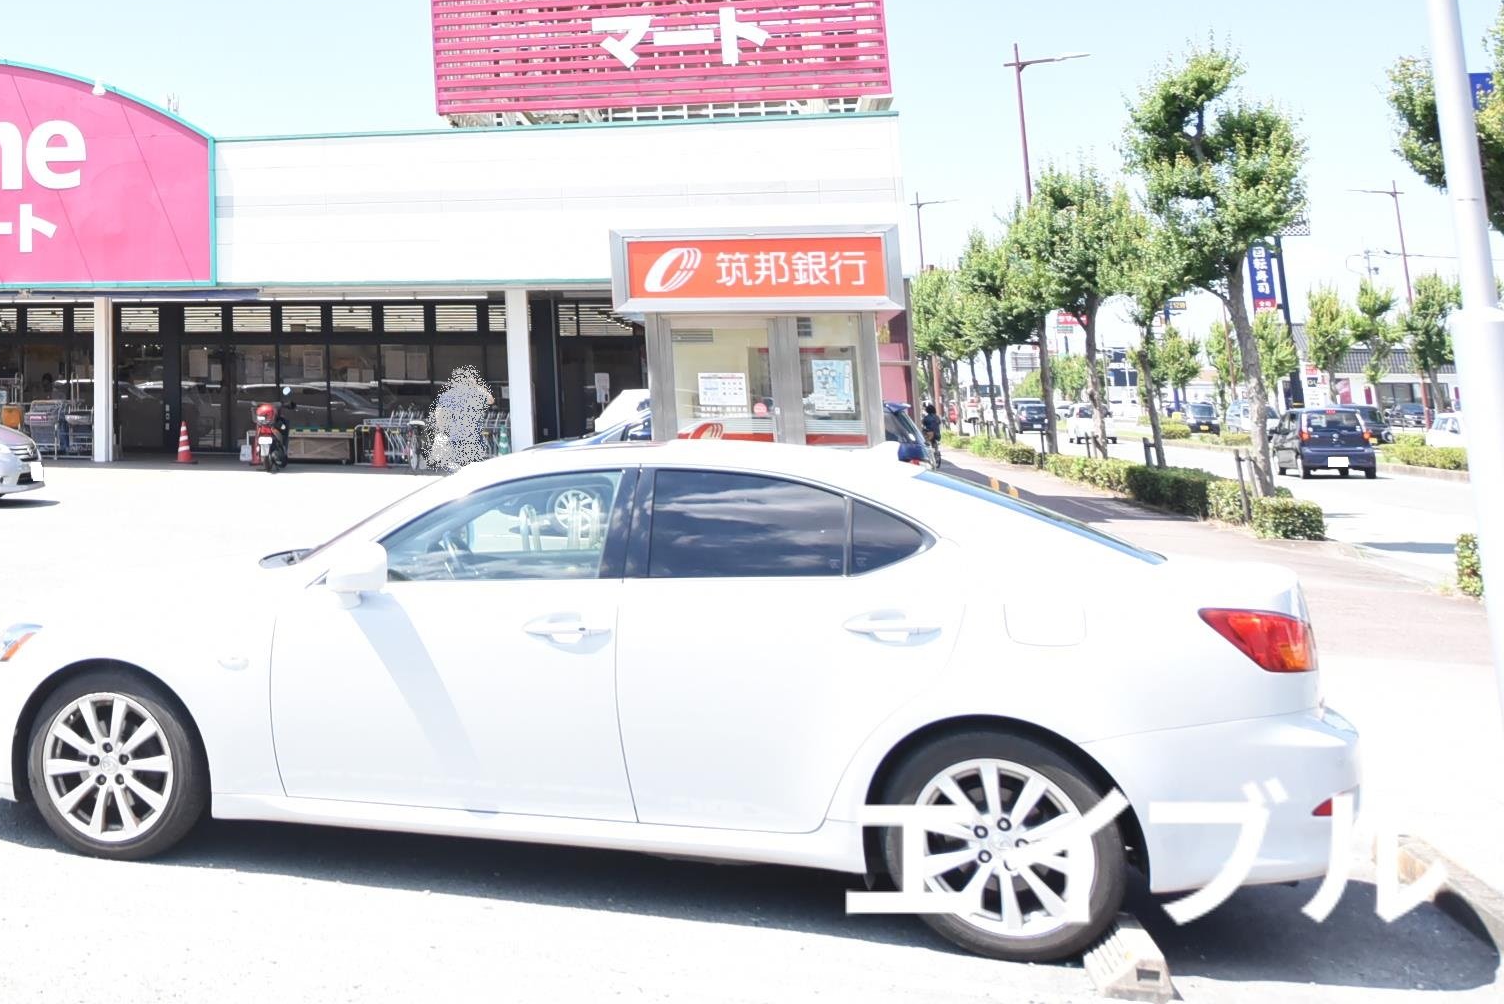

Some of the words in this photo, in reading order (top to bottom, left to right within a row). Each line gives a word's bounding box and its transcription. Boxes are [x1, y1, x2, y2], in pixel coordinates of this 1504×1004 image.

[591, 7, 770, 68] マート
[715, 251, 868, 286] 筑邦銀行
[1252, 246, 1271, 295] 回転寿司
